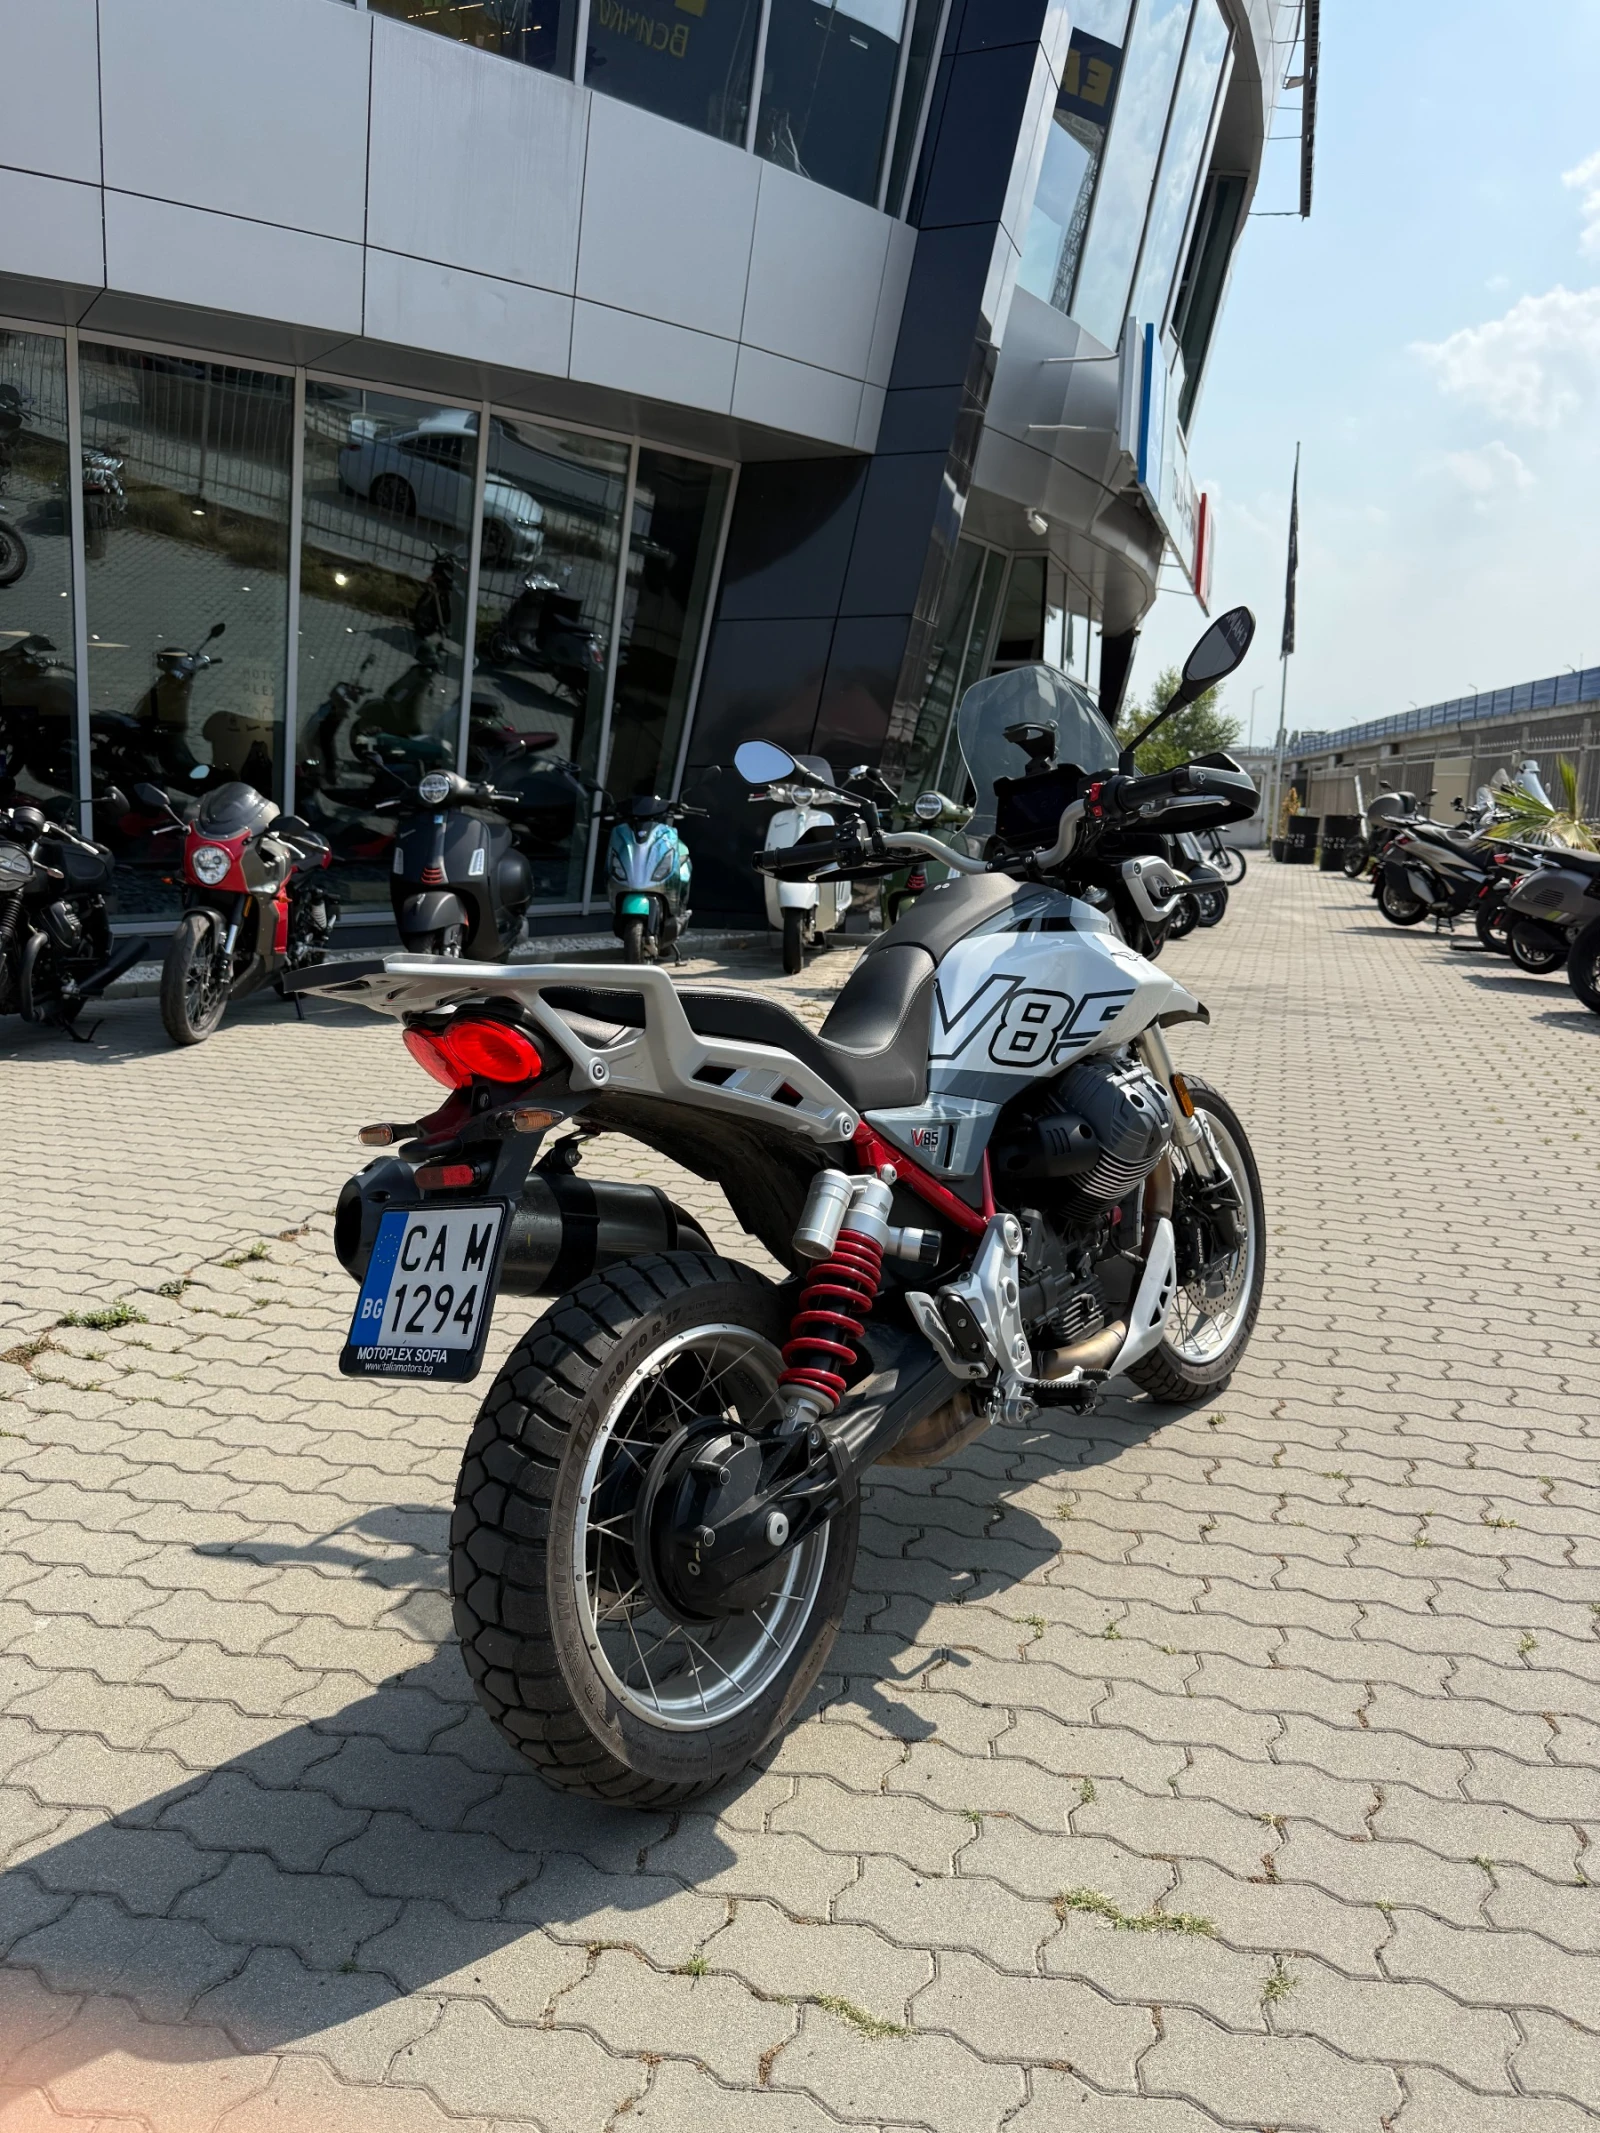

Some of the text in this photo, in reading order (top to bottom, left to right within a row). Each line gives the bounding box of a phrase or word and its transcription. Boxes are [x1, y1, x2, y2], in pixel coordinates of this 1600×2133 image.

[911, 1128, 939, 1147] V85
[400, 1223, 493, 1272] CA M
[361, 1297, 385, 1319] BG
[391, 1283, 478, 1335] 1294
[356, 1347, 448, 1363] MOTOPLEX SOFIA
[602, 1333, 648, 1397] 150/70
[650, 1320, 662, 1335] R
[665, 1307, 682, 1326] 17
[553, 1398, 601, 1622] MICHELIN
